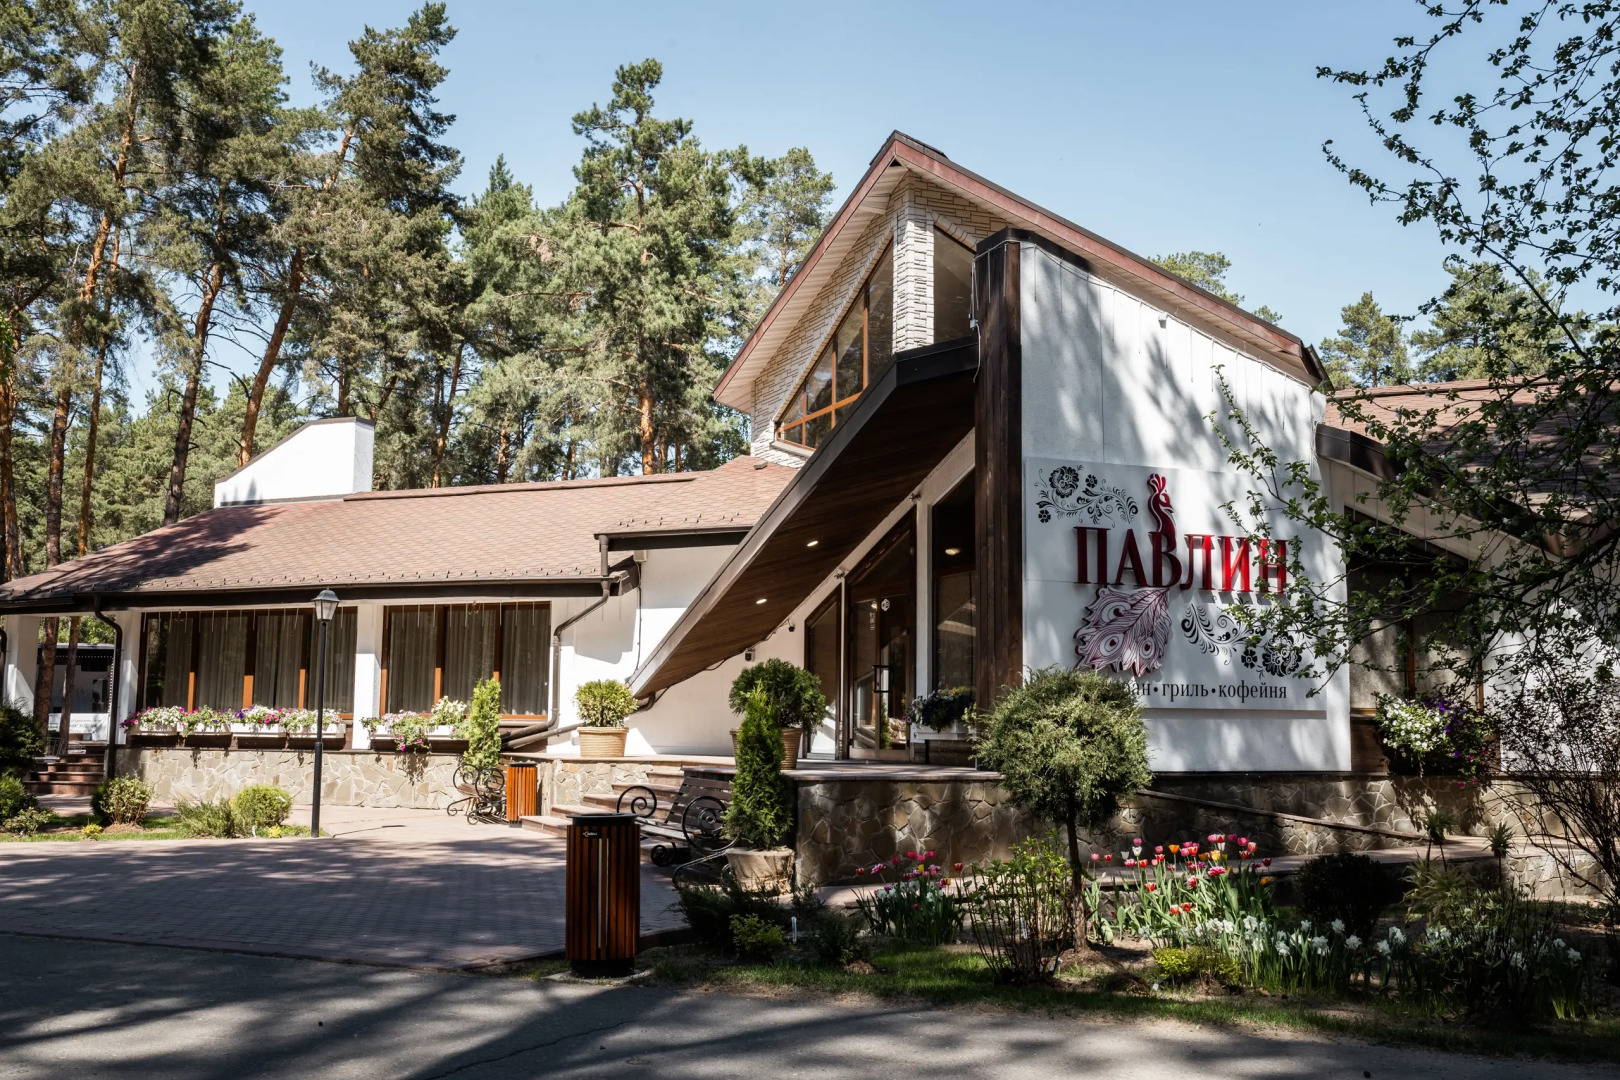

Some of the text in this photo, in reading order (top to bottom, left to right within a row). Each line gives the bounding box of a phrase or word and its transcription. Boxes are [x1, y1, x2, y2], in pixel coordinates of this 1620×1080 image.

[1073, 526, 1288, 594] ПАВЛИН
[1162, 682, 1209, 702] гриль
[1218, 680, 1287, 703] кофейня
